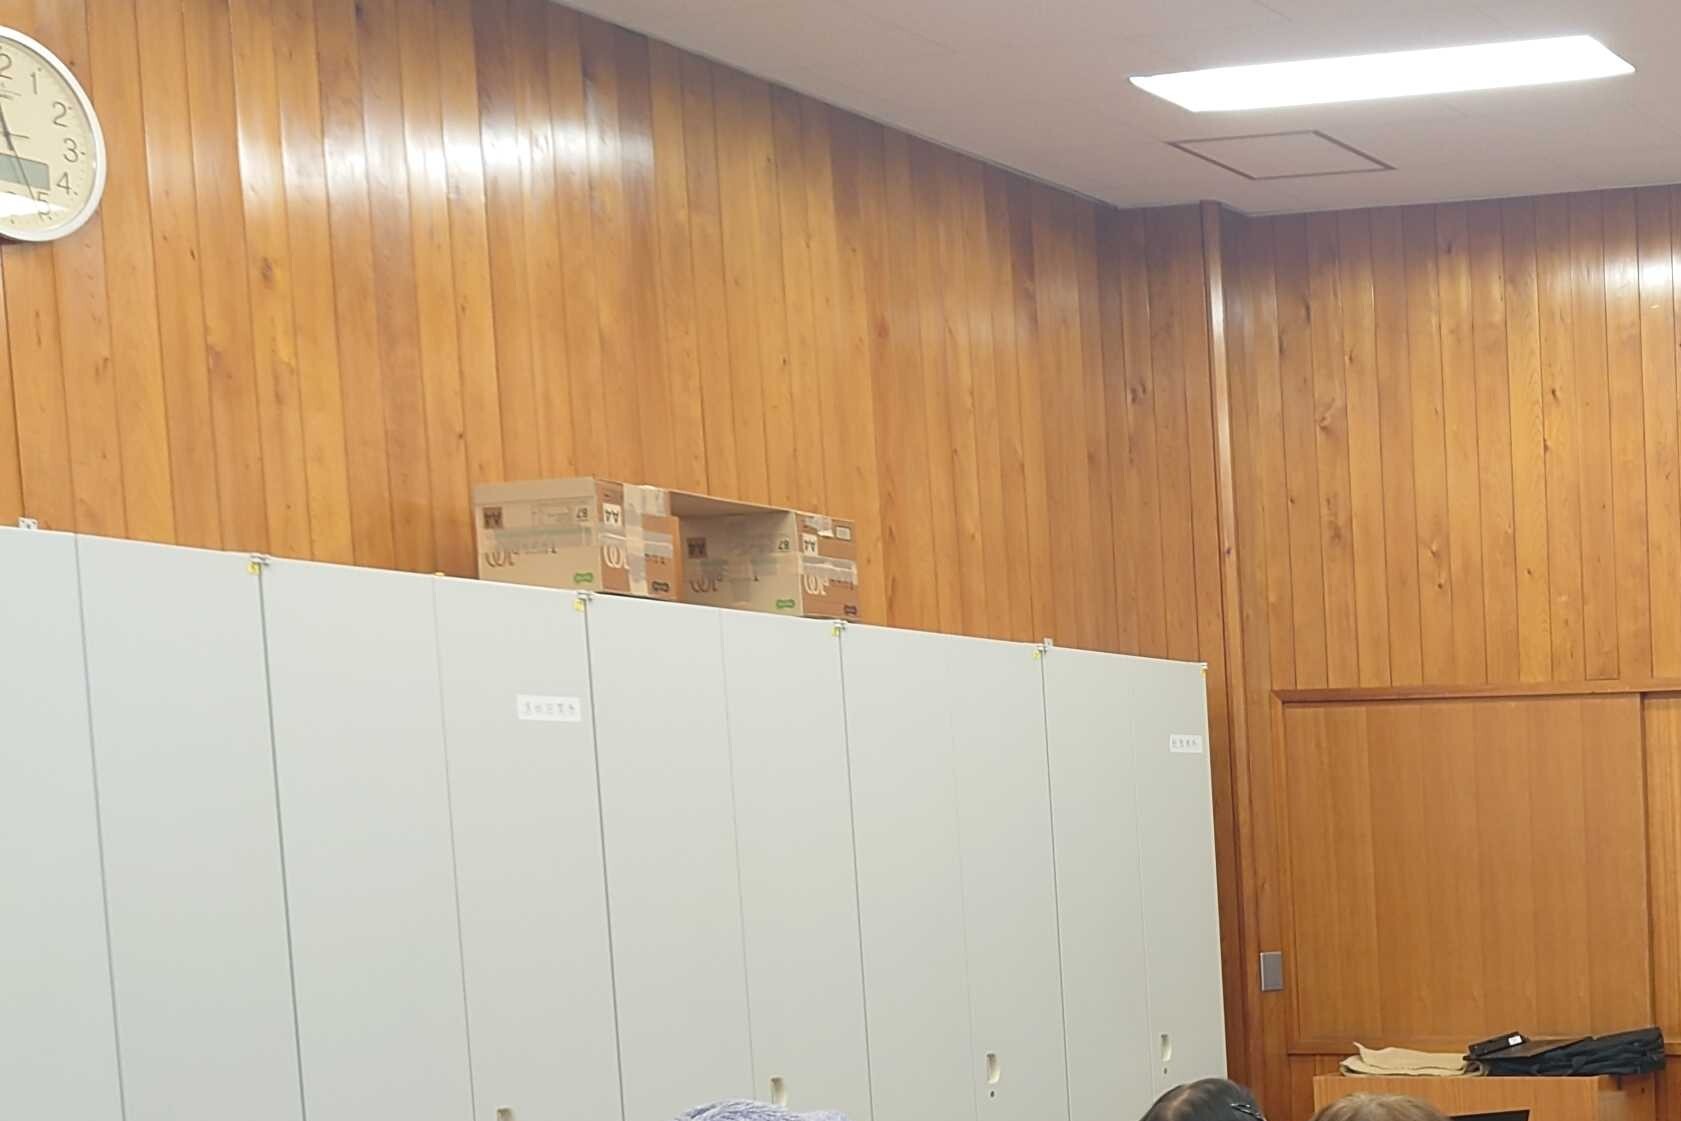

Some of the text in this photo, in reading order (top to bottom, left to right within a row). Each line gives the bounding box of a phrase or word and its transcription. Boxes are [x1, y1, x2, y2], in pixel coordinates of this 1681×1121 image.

[30, 71, 39, 96] 1
[52, 100, 68, 128] 2
[63, 137, 80, 164] 3
[55, 171, 72, 196] 4
